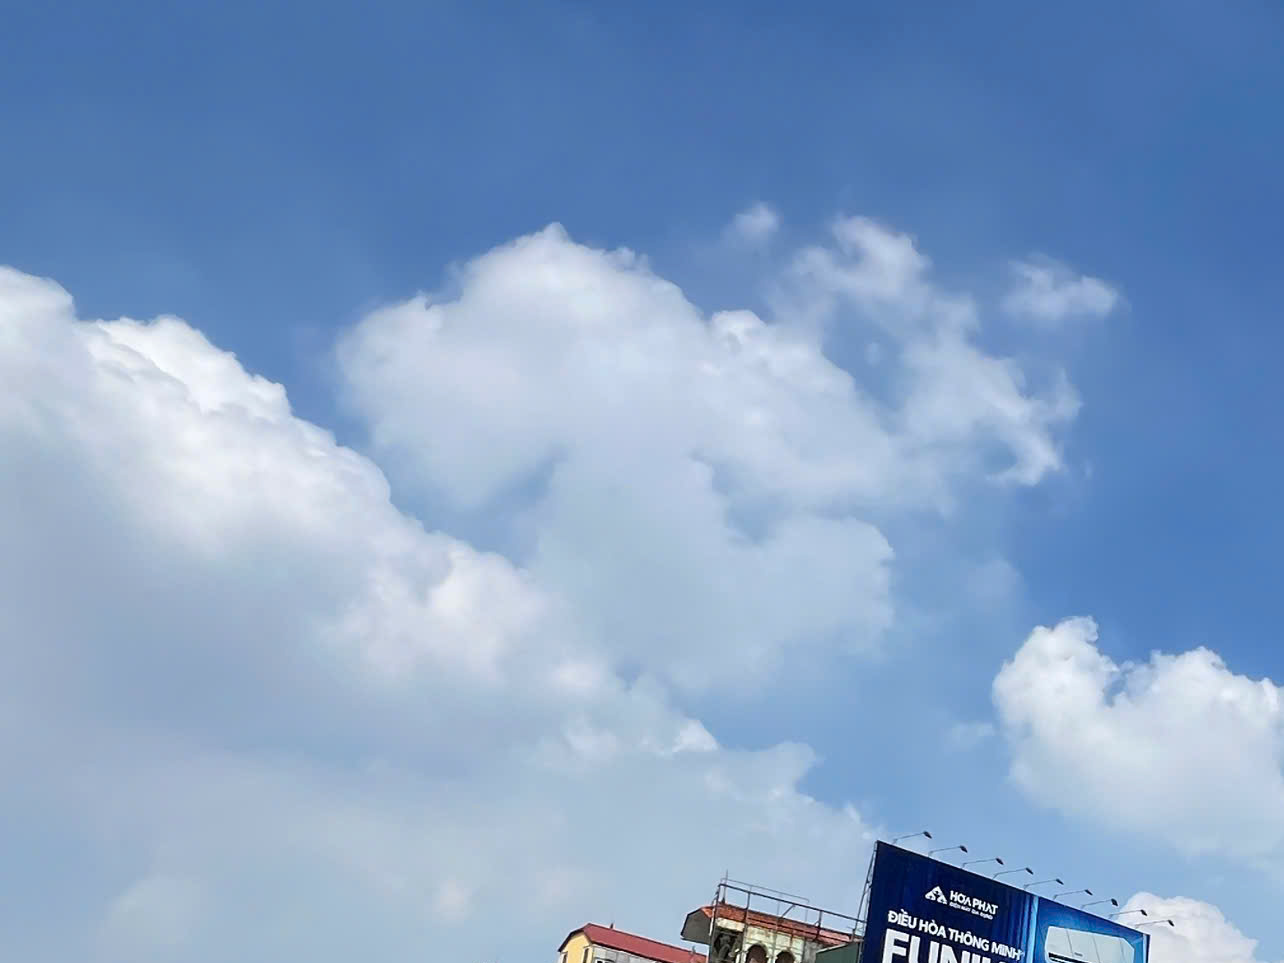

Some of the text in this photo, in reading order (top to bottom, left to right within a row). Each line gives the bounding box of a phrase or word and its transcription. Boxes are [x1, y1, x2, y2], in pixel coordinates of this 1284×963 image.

[888, 908, 1021, 961] ĐIỀU HÒA THÔNG MINH
